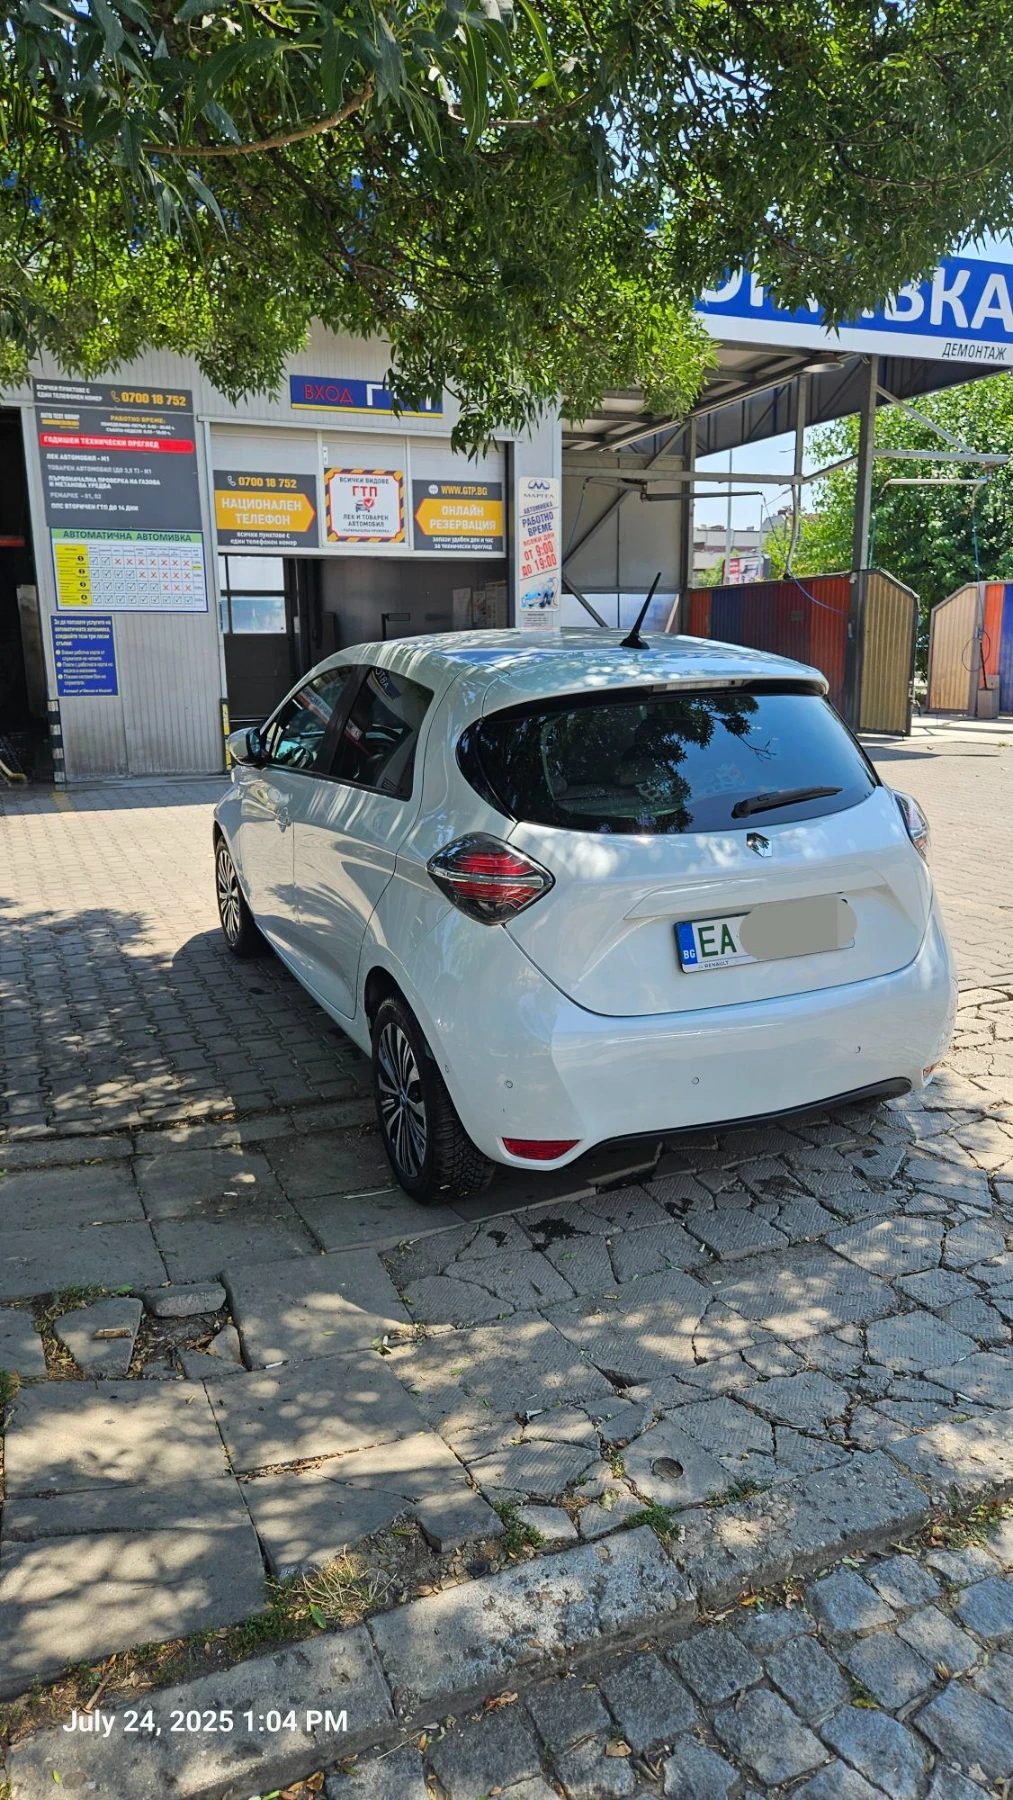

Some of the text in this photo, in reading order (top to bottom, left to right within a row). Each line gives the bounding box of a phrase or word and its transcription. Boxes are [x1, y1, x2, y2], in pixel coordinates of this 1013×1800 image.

[941, 342, 1007, 360] ДЕМОНТАЖ
[121, 391, 187, 407] 0700 18 752
[304, 384, 354, 404] ВХОД
[110, 415, 140, 423] РАБОТНО
[43, 435, 160, 449] ГОДИШЕН ТЕХНИЧЕСКИ ПРЕГЛЕД
[76, 465, 112, 473] АВТОМОБИЛ
[138, 478, 161, 486] ГАЗОВА
[238, 476, 297, 489] 0700 18 752
[339, 476, 389, 485] ВСИЧКИ ВИДОВЕ
[352, 485, 378, 497] ГТП
[440, 485, 488, 496] WWW.GTP.BG
[221, 497, 302, 511] НАЦИОНАЛЕН
[441, 504, 484, 516] ОНЛАЙН
[523, 501, 553, 514] АВТОМИВКА
[235, 513, 291, 525] ТЕЛЕФОН
[429, 519, 496, 531] РЕЗЕРВАЦИЯ
[521, 511, 554, 528] РАБОТНО
[527, 522, 553, 537] ВРЕМЕ
[63, 530, 192, 542] АВТОМАТИЧНА АВТОМИВКА
[524, 540, 554, 561] ОТ 9:00
[521, 553, 557, 577] ДО 19:00
[697, 923, 737, 958] EA
[683, 948, 696, 960] BG
[704, 960, 729, 968] RENAULT
